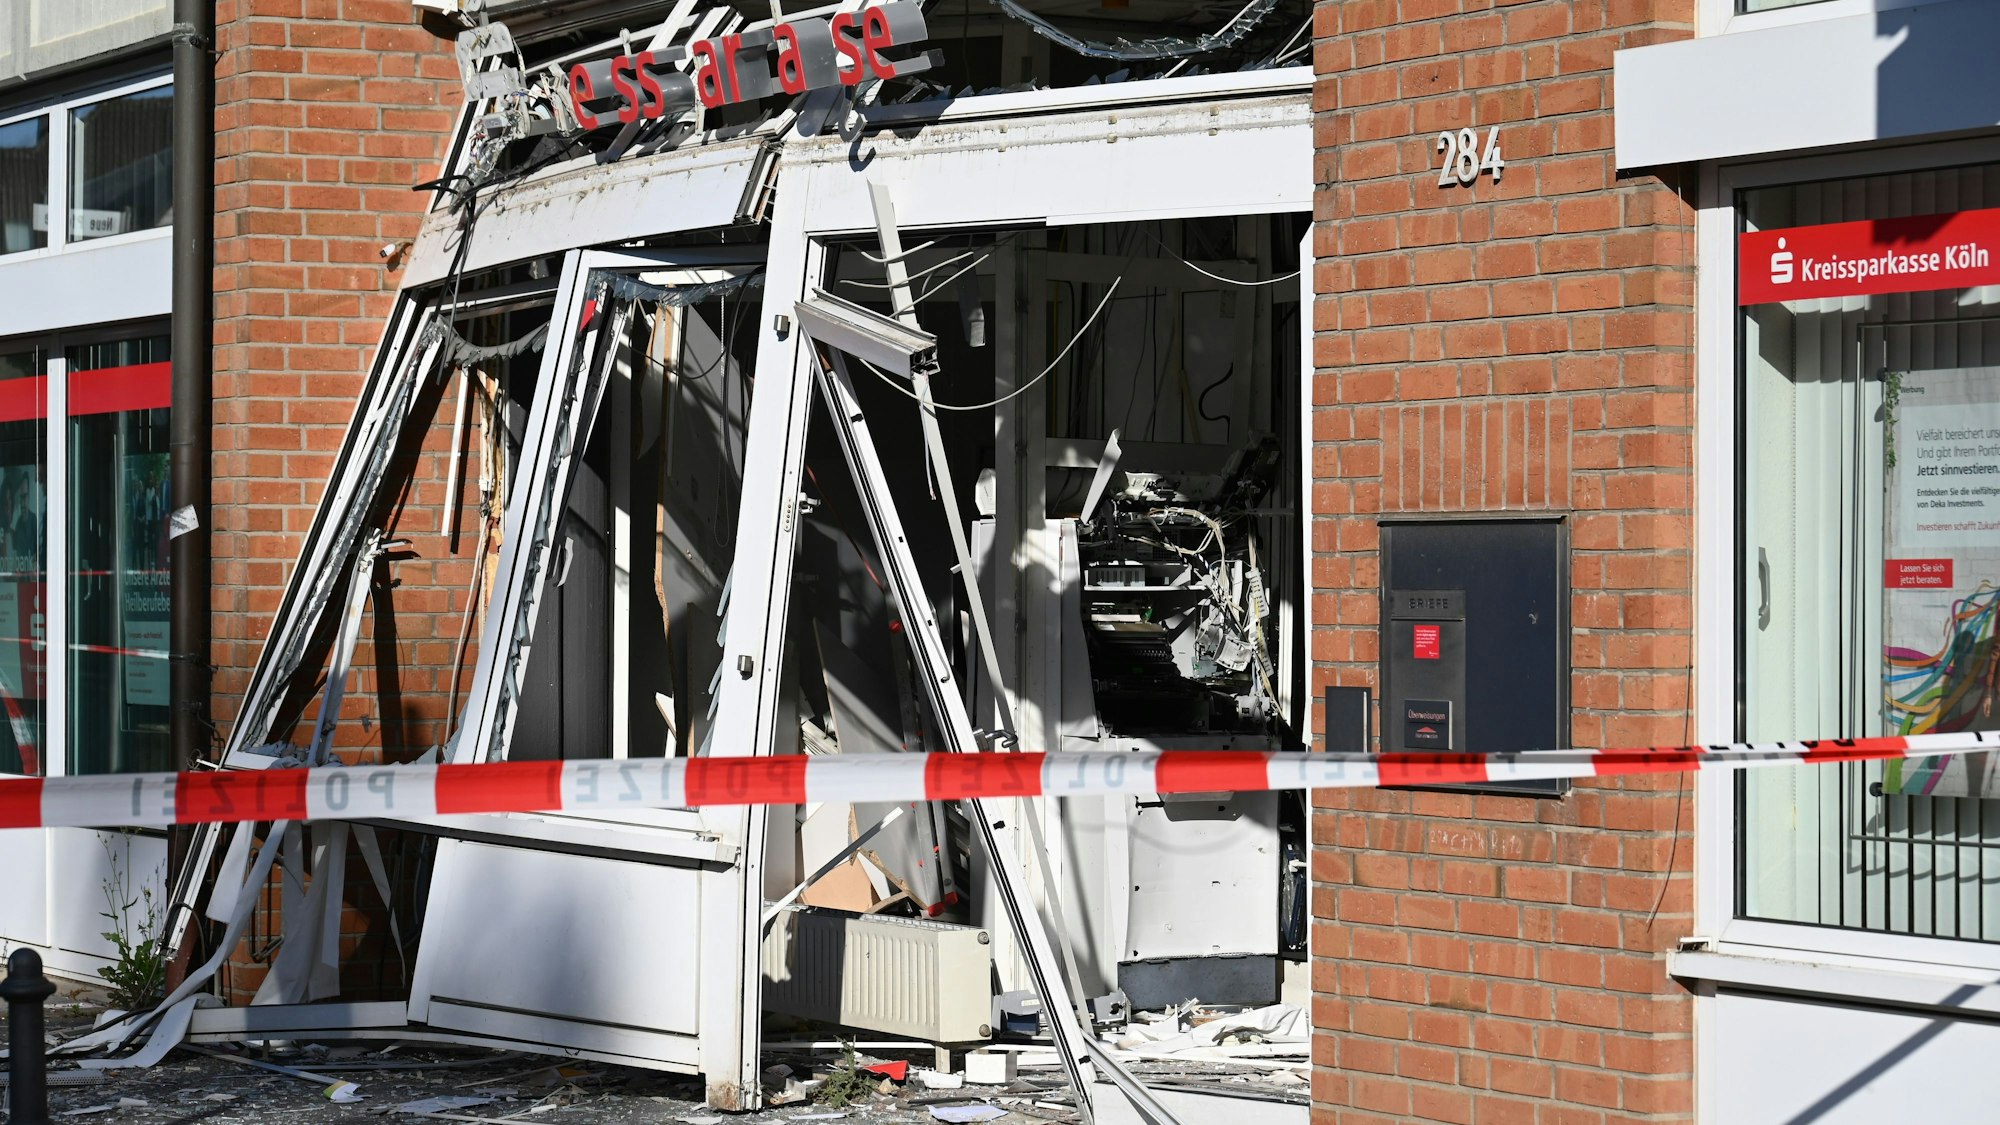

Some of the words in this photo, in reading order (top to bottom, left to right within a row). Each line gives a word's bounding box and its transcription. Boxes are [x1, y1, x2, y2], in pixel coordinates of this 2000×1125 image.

[1437, 126, 1504, 187] 284
[1801, 249, 1940, 284] Kreissparkasse
[1945, 242, 1989, 270] Köln
[1900, 386, 1925, 395] Werbung
[1916, 428, 1943, 441] Vielfalt
[1945, 427, 1983, 440] bereichert
[1917, 446, 1933, 459] Und
[1936, 446, 1951, 461] gibt
[1954, 445, 1976, 457] Ihrem
[1917, 465, 1938, 477] Jetzt
[1916, 488, 1948, 497] Entdecken
[1950, 487, 1959, 496] Sie
[1960, 487, 1970, 496] die
[1917, 501, 1929, 509] von
[1930, 500, 1945, 508] Deka
[1947, 499, 1985, 508] Investments.
[1916, 522, 1952, 532] Investieren
[1900, 563, 1921, 573] Lassen
[1922, 562, 1931, 572] Sie
[1932, 562, 1945, 572] sich
[1900, 576, 1914, 586] jetzt
[1916, 575, 1943, 585] beraten.
[1409, 598, 1448, 609] BRIEFE
[1408, 709, 1446, 722] Überweisungen
